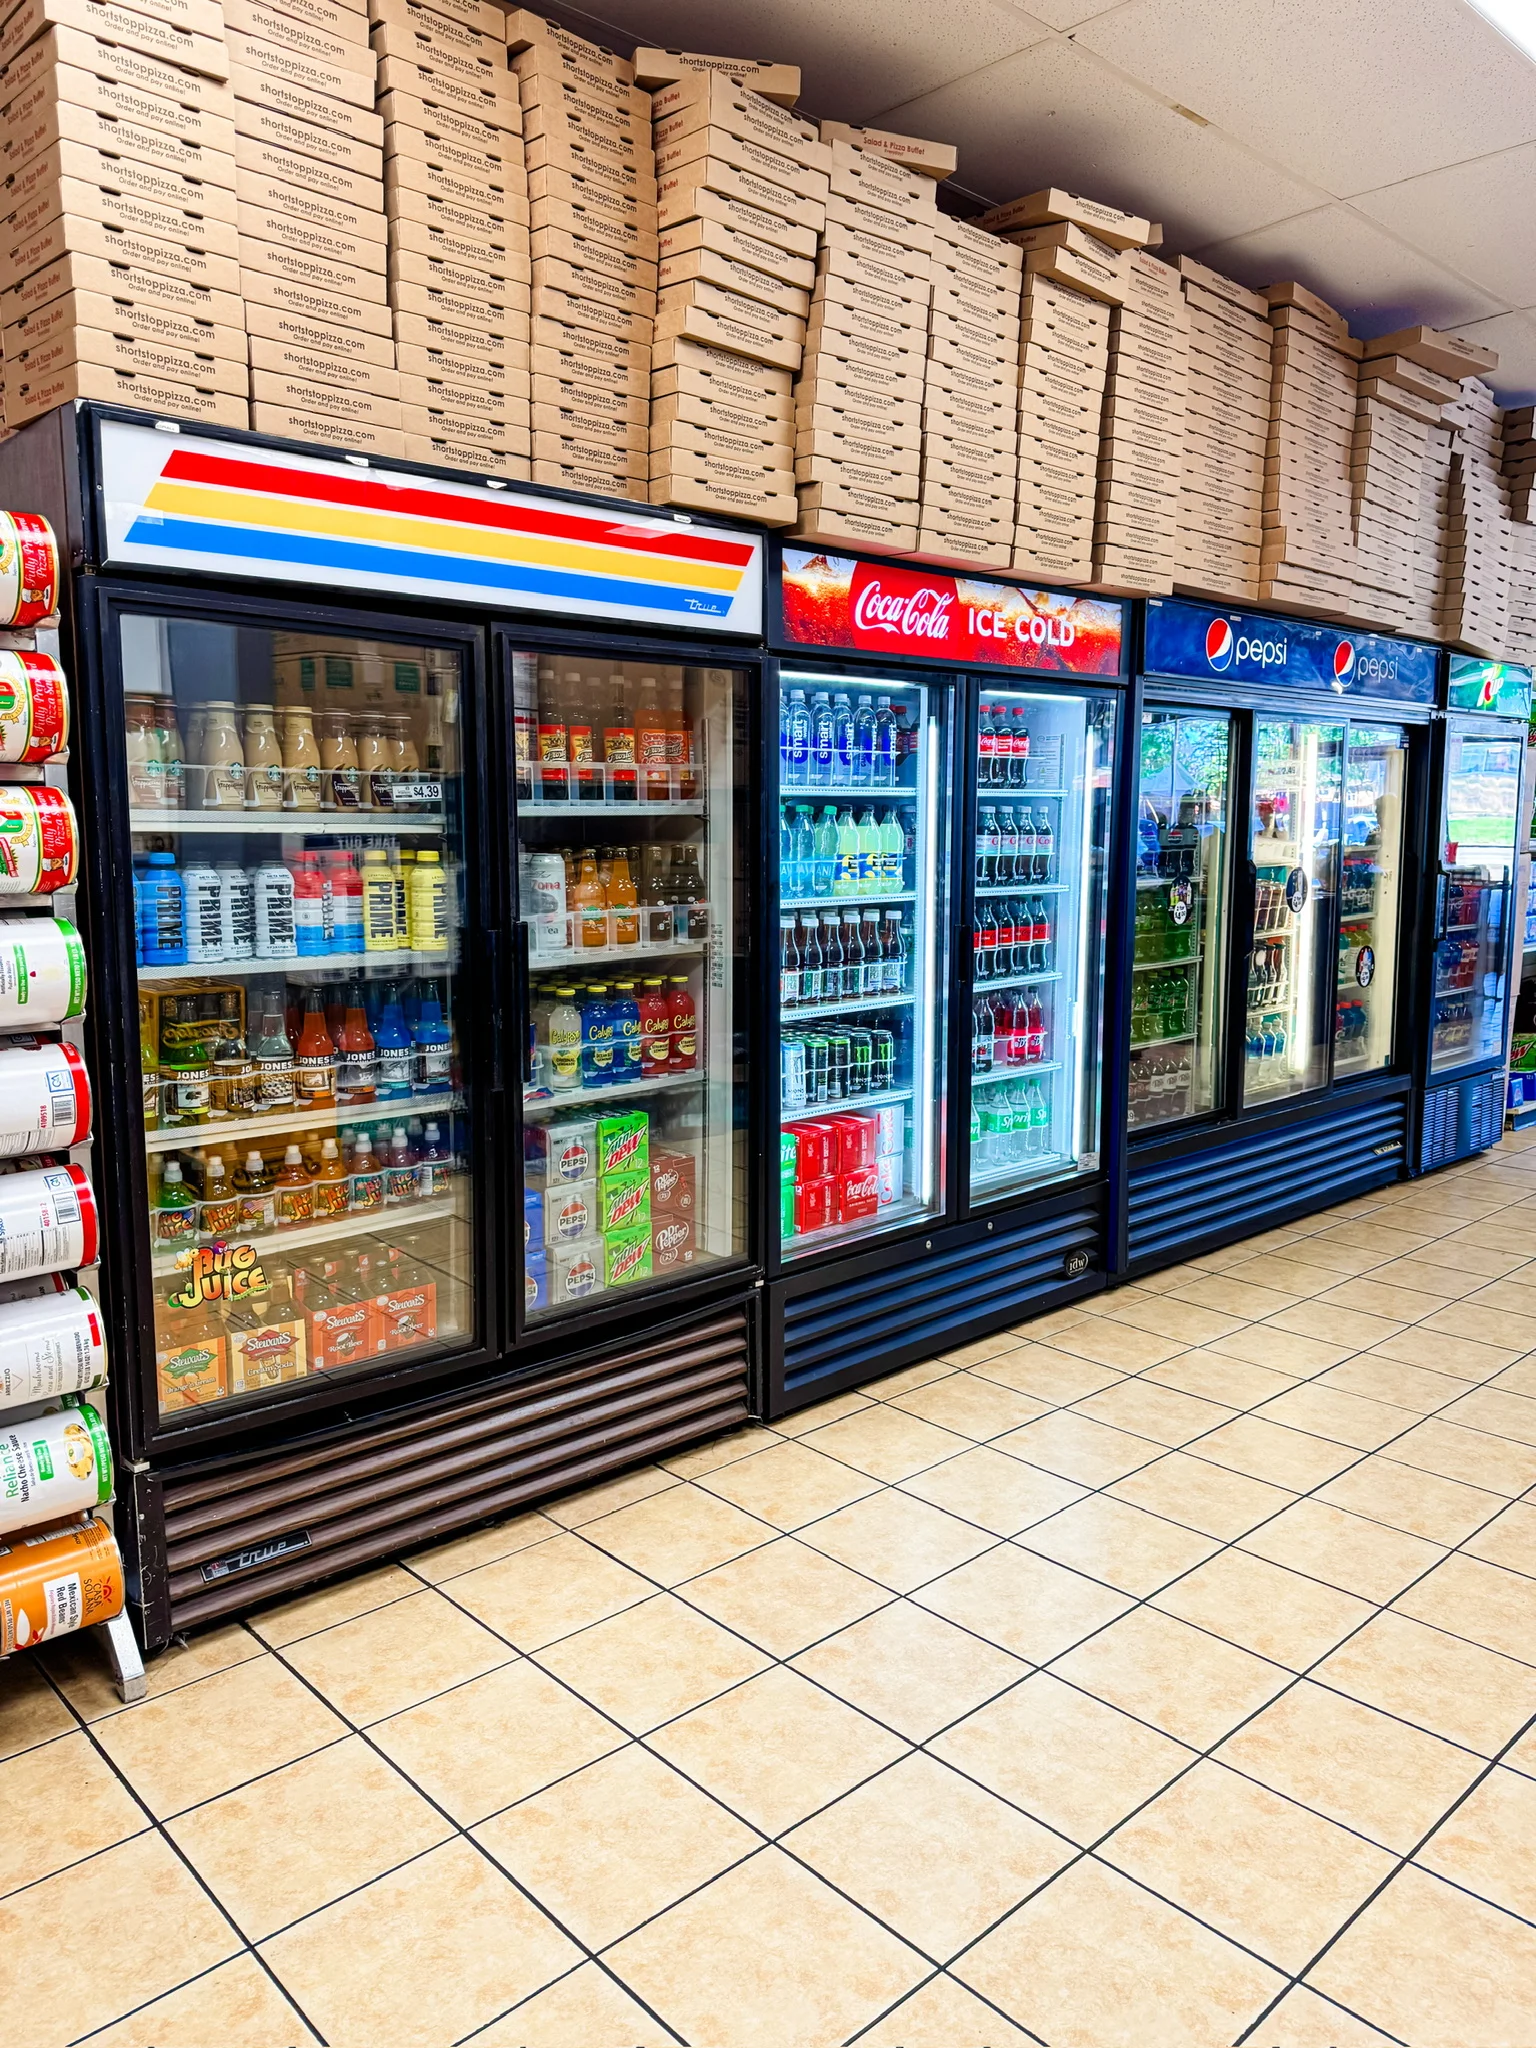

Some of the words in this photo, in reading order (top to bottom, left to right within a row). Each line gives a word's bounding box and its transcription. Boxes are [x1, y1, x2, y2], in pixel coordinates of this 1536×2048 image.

[87, 3, 193, 48] shortstoppizza.com
[253, 13, 345, 56] shortstoppizza.com
[407, 7, 482, 45] shortstoppizza.com
[547, 28, 612, 64] shortstoppizza.com
[98, 49, 200, 93] shortstoppizza.com
[679, 57, 759, 73] shortstoppizza.com
[419, 72, 496, 107] shortstoppizza.com
[261, 84, 352, 123] shortstoppizza.com
[564, 94, 630, 125] shortstoppizza.com
[99, 120, 202, 161] shortstoppizza.com
[744, 115, 803, 144] shortstoppizza.com
[426, 139, 502, 171] shortstoppizza.com
[860, 155, 911, 177] shortstoppizza.com
[263, 153, 353, 189] shortstoppizza.com
[572, 182, 636, 210] shortstoppizza.com
[102, 197, 204, 234] shortstoppizza.com
[728, 205, 787, 230] shortstoppizza.com
[267, 220, 355, 252] shortstoppizza.com
[429, 234, 505, 261] shortstoppizza.com
[853, 234, 904, 255] shortstoppizza.com
[105, 234, 206, 269] shortstoppizza.com
[111, 269, 211, 302] shortstoppizza.com
[116, 307, 215, 339] shortstoppizza.com
[279, 321, 365, 349] shortstoppizza.com
[563, 332, 629, 355] shortstoppizza.com
[116, 344, 216, 375] shortstoppizza.com
[429, 355, 505, 378] shortstoppizza.com
[846, 366, 897, 381] shortstoppizza.com
[118, 380, 216, 409] shortstoppizza.com
[287, 385, 372, 411] shortstoppizza.com
[561, 387, 627, 407] shortstoppizza.com
[710, 379, 766, 398] shortstoppizza.com
[429, 416, 505, 435] shortstoppizza.com
[562, 471, 627, 488] shortstoppizza.com
[706, 487, 766, 501] shortstoppizza.com
[845, 519, 893, 532] shortstoppizza.com
[854, 580, 955, 640] Coca-Cola
[968, 607, 1007, 640] ICE
[1015, 614, 1076, 648] COLD
[1236, 635, 1288, 669] pepsi
[1358, 655, 1400, 681] pepsi
[792, 719, 803, 759] smart
[820, 720, 829, 759] smart
[413, 785, 440, 799] $4.39
[157, 886, 183, 949] PRIME
[199, 886, 222, 947] PRIME
[266, 884, 295, 946] PRIME
[368, 881, 394, 939] PRIME
[260, 1061, 293, 1071] JONES
[347, 1051, 376, 1063] JONES
[380, 1048, 410, 1058] JONES
[177, 1069, 209, 1080] JONES
[560, 1156, 587, 1169] PEPSI
[653, 1164, 660, 1173] 12
[559, 1213, 587, 1227] PEPSI
[666, 1225, 679, 1236] Dr
[657, 1229, 688, 1250] Pepper
[198, 1244, 256, 1274] BUG
[361, 1256, 369, 1266] 4
[684, 1251, 692, 1260] 12
[178, 1256, 269, 1308] JUICE
[567, 1271, 594, 1286] PEPSI
[390, 1328, 407, 1336] Root
[407, 1322, 424, 1331] Beer
[328, 1344, 347, 1353] Root
[346, 1339, 363, 1349] Beer
[247, 1365, 274, 1377] Cream
[274, 1360, 295, 1370] Soda
[9, 1434, 20, 1452] Sauce
[16, 1451, 28, 1479] Cheese
[19, 1480, 30, 1503] Nacho
[56, 1586, 66, 1603] Red
[67, 1582, 78, 1614] Mexican
[83, 1578, 95, 1617] SOLANA
[93, 1583, 104, 1609] CASA
[58, 1602, 68, 1624] Beans
